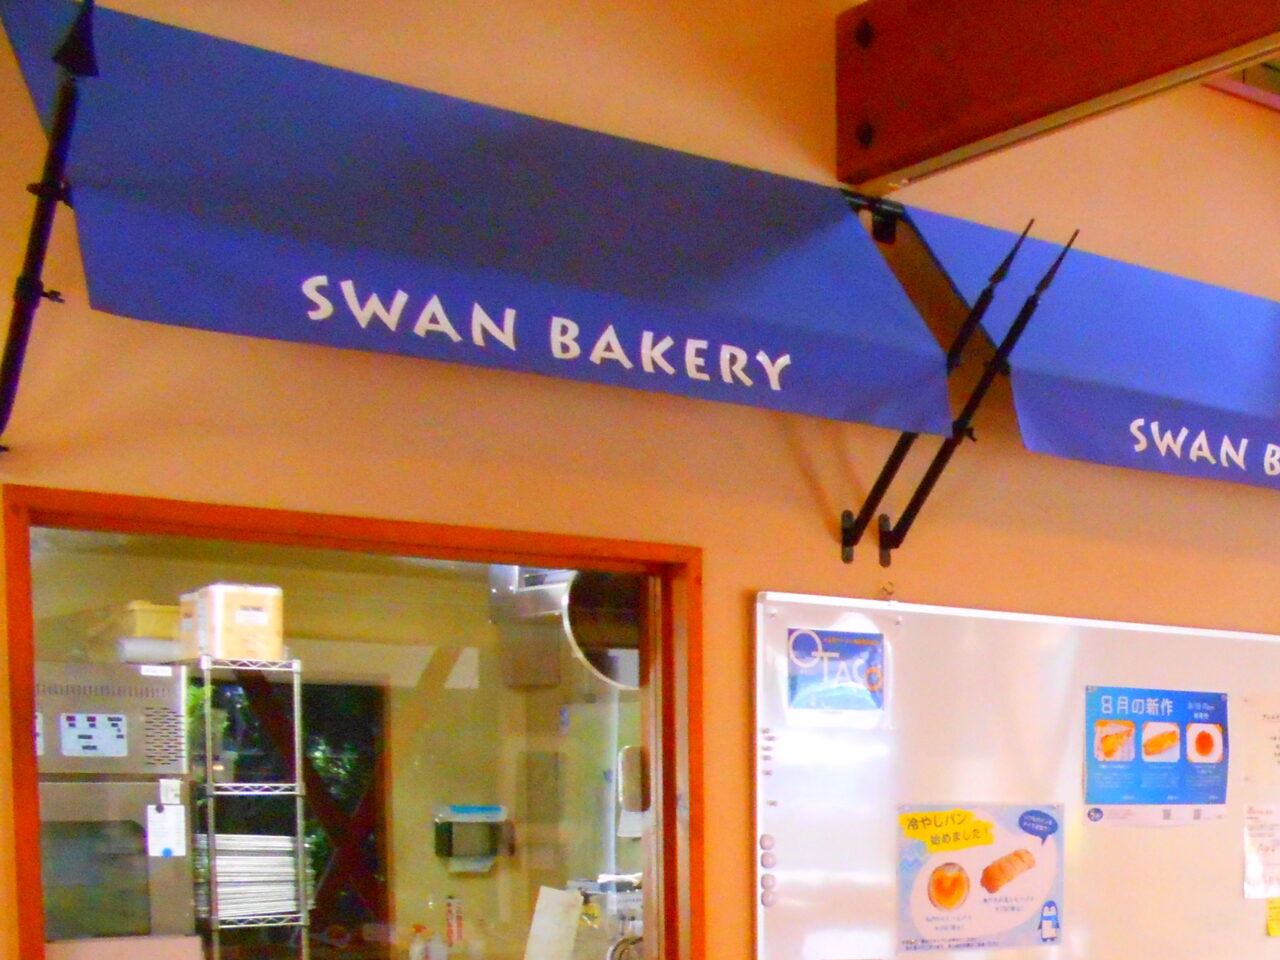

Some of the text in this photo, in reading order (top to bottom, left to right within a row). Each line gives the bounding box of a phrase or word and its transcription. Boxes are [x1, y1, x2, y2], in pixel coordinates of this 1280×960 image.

[301, 275, 791, 391] SWAN BAKERY
[1129, 418, 1248, 471] SWAN
[1101, 695, 1174, 716] 8月の新作
[907, 813, 967, 831] 冷やしパン
